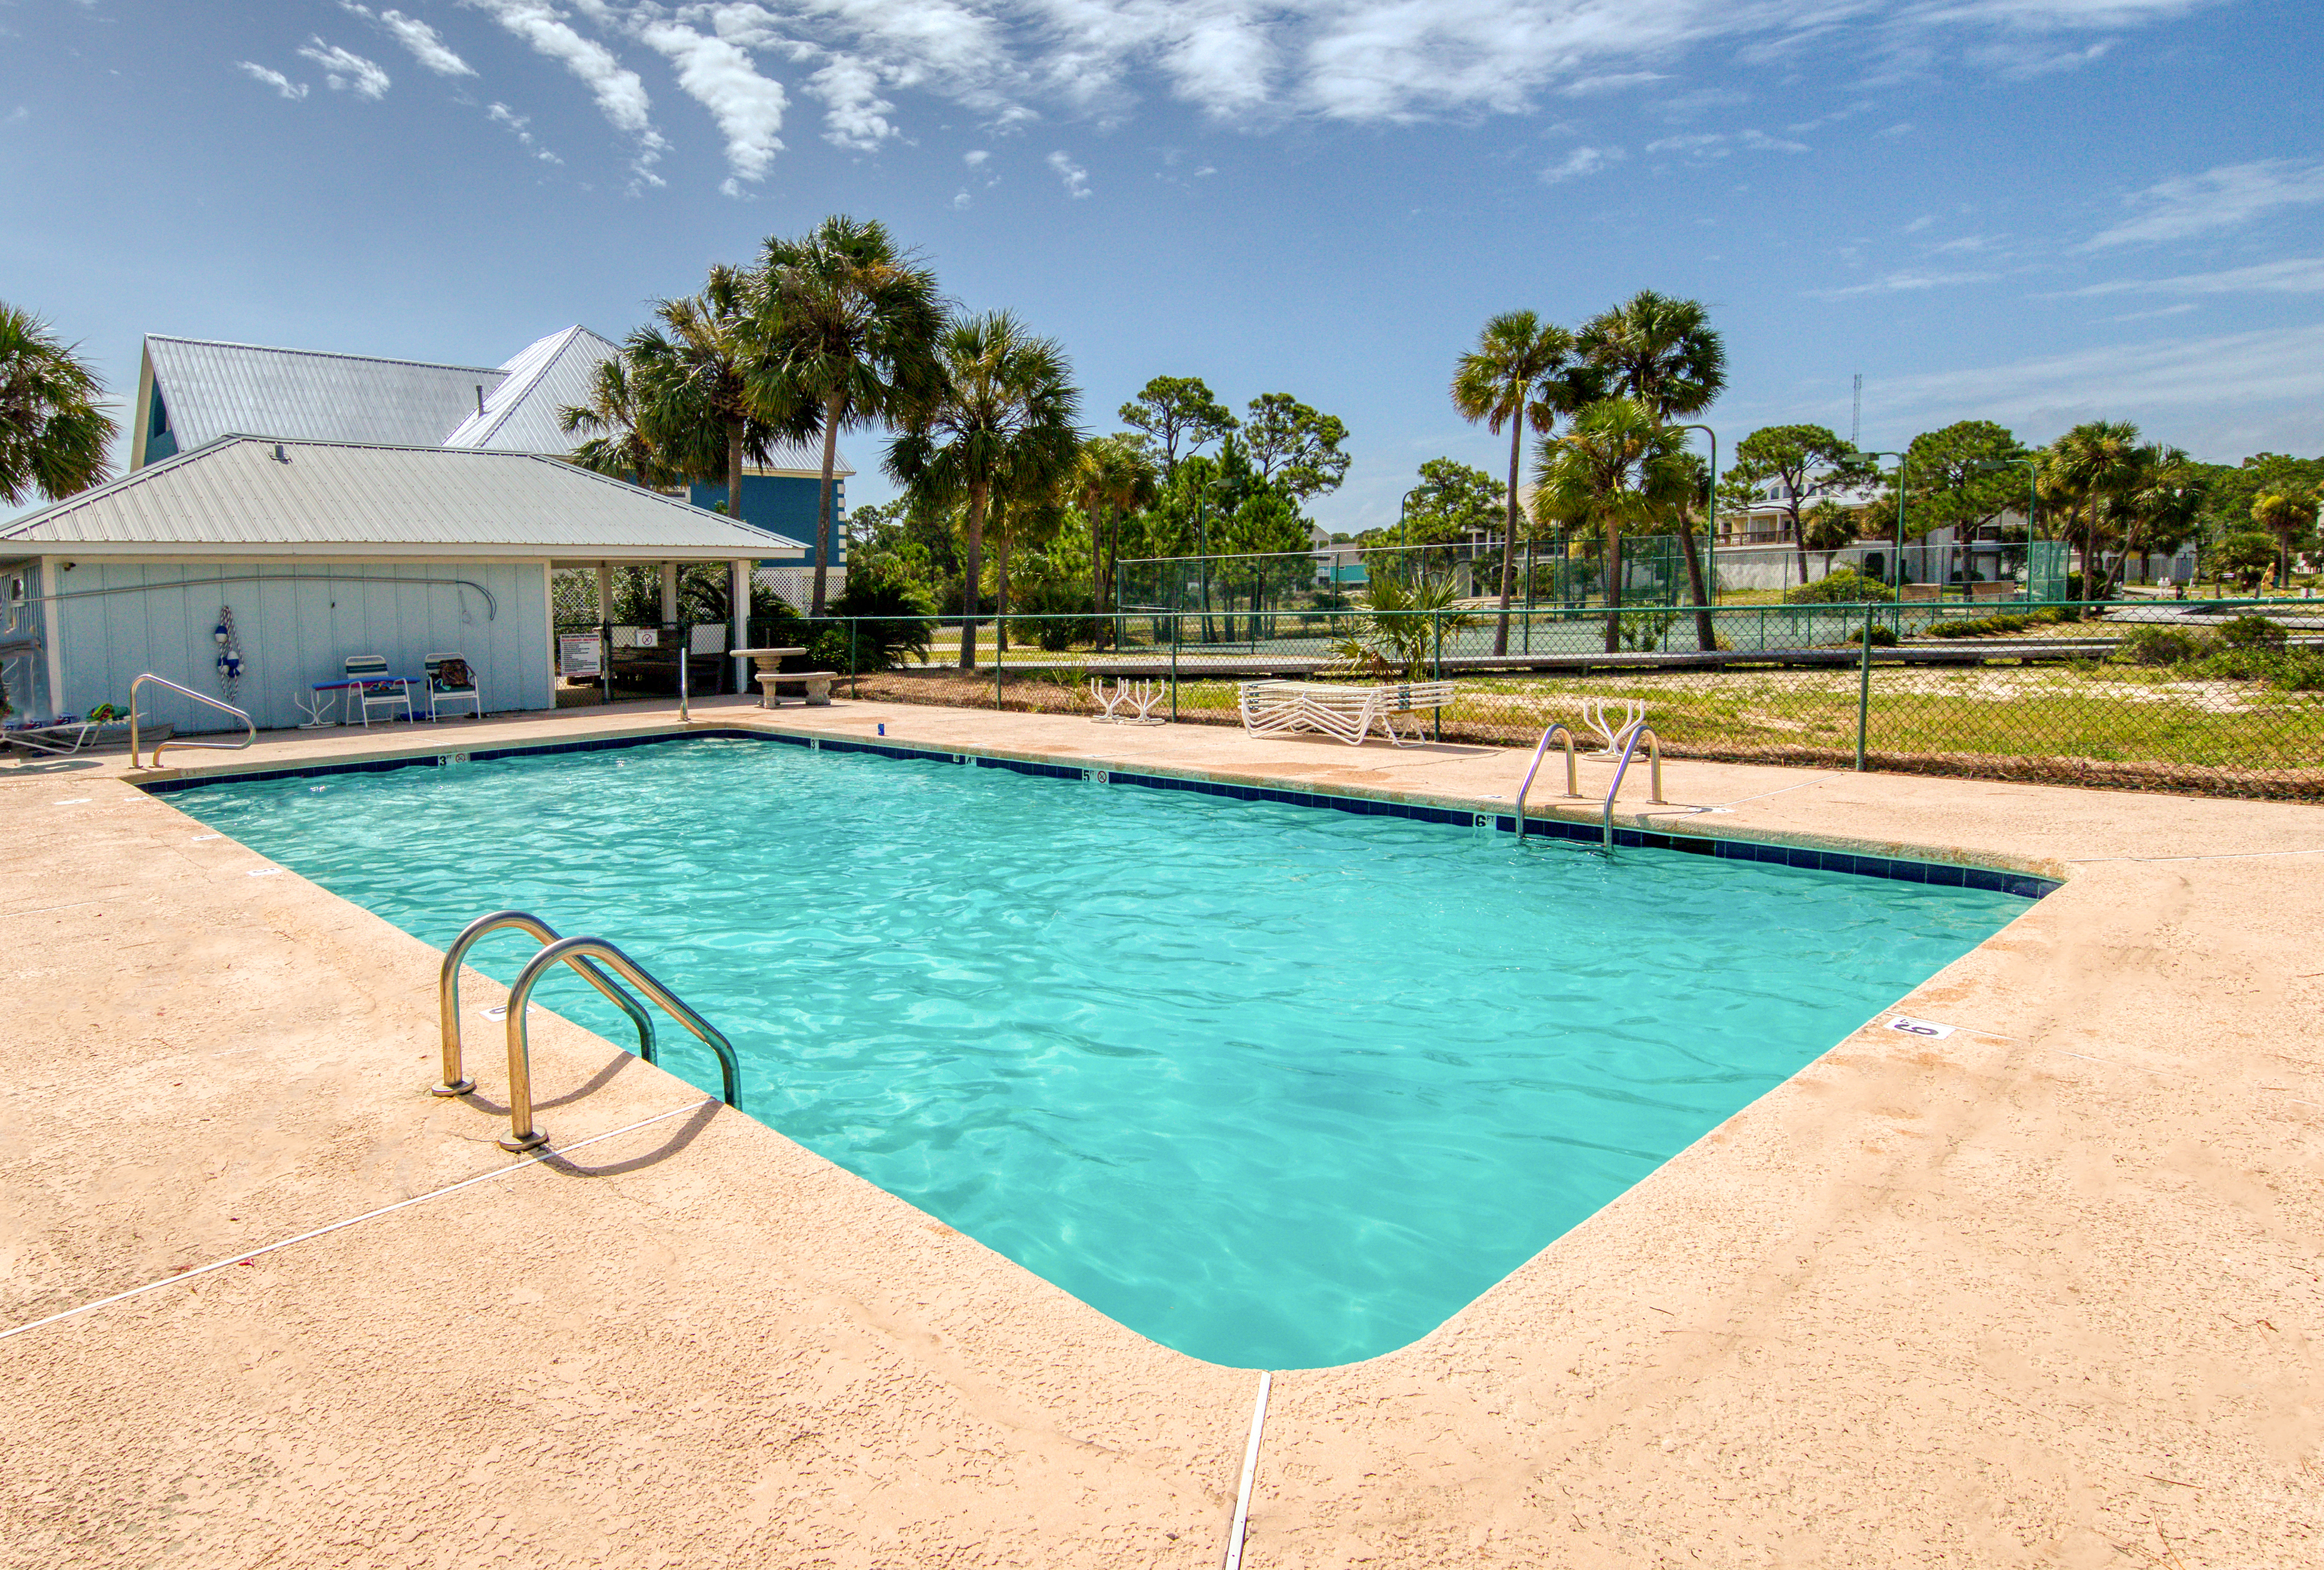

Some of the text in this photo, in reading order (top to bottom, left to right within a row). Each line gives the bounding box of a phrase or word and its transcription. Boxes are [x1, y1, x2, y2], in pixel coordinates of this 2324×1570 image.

[811, 739, 815, 749] 3
[440, 756, 447, 766] 3
[1084, 770, 1090, 782] 5
[1475, 814, 1486, 827] 6
